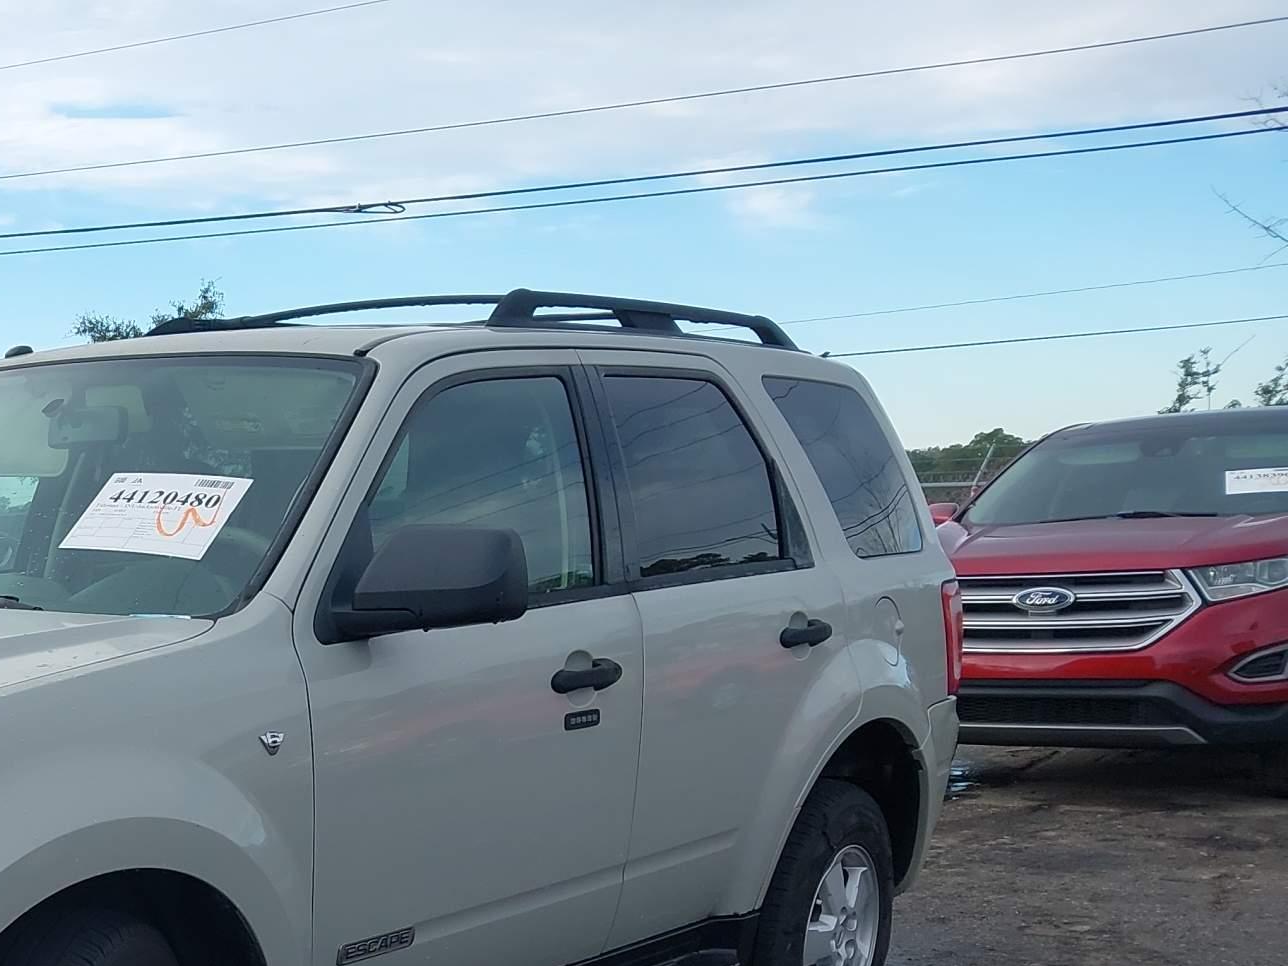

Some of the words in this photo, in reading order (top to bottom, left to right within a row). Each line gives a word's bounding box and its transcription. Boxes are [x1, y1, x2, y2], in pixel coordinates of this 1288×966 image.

[109, 489, 221, 508] 44120480
[1026, 591, 1059, 604] Ford
[343, 929, 411, 960] ESCAPE
